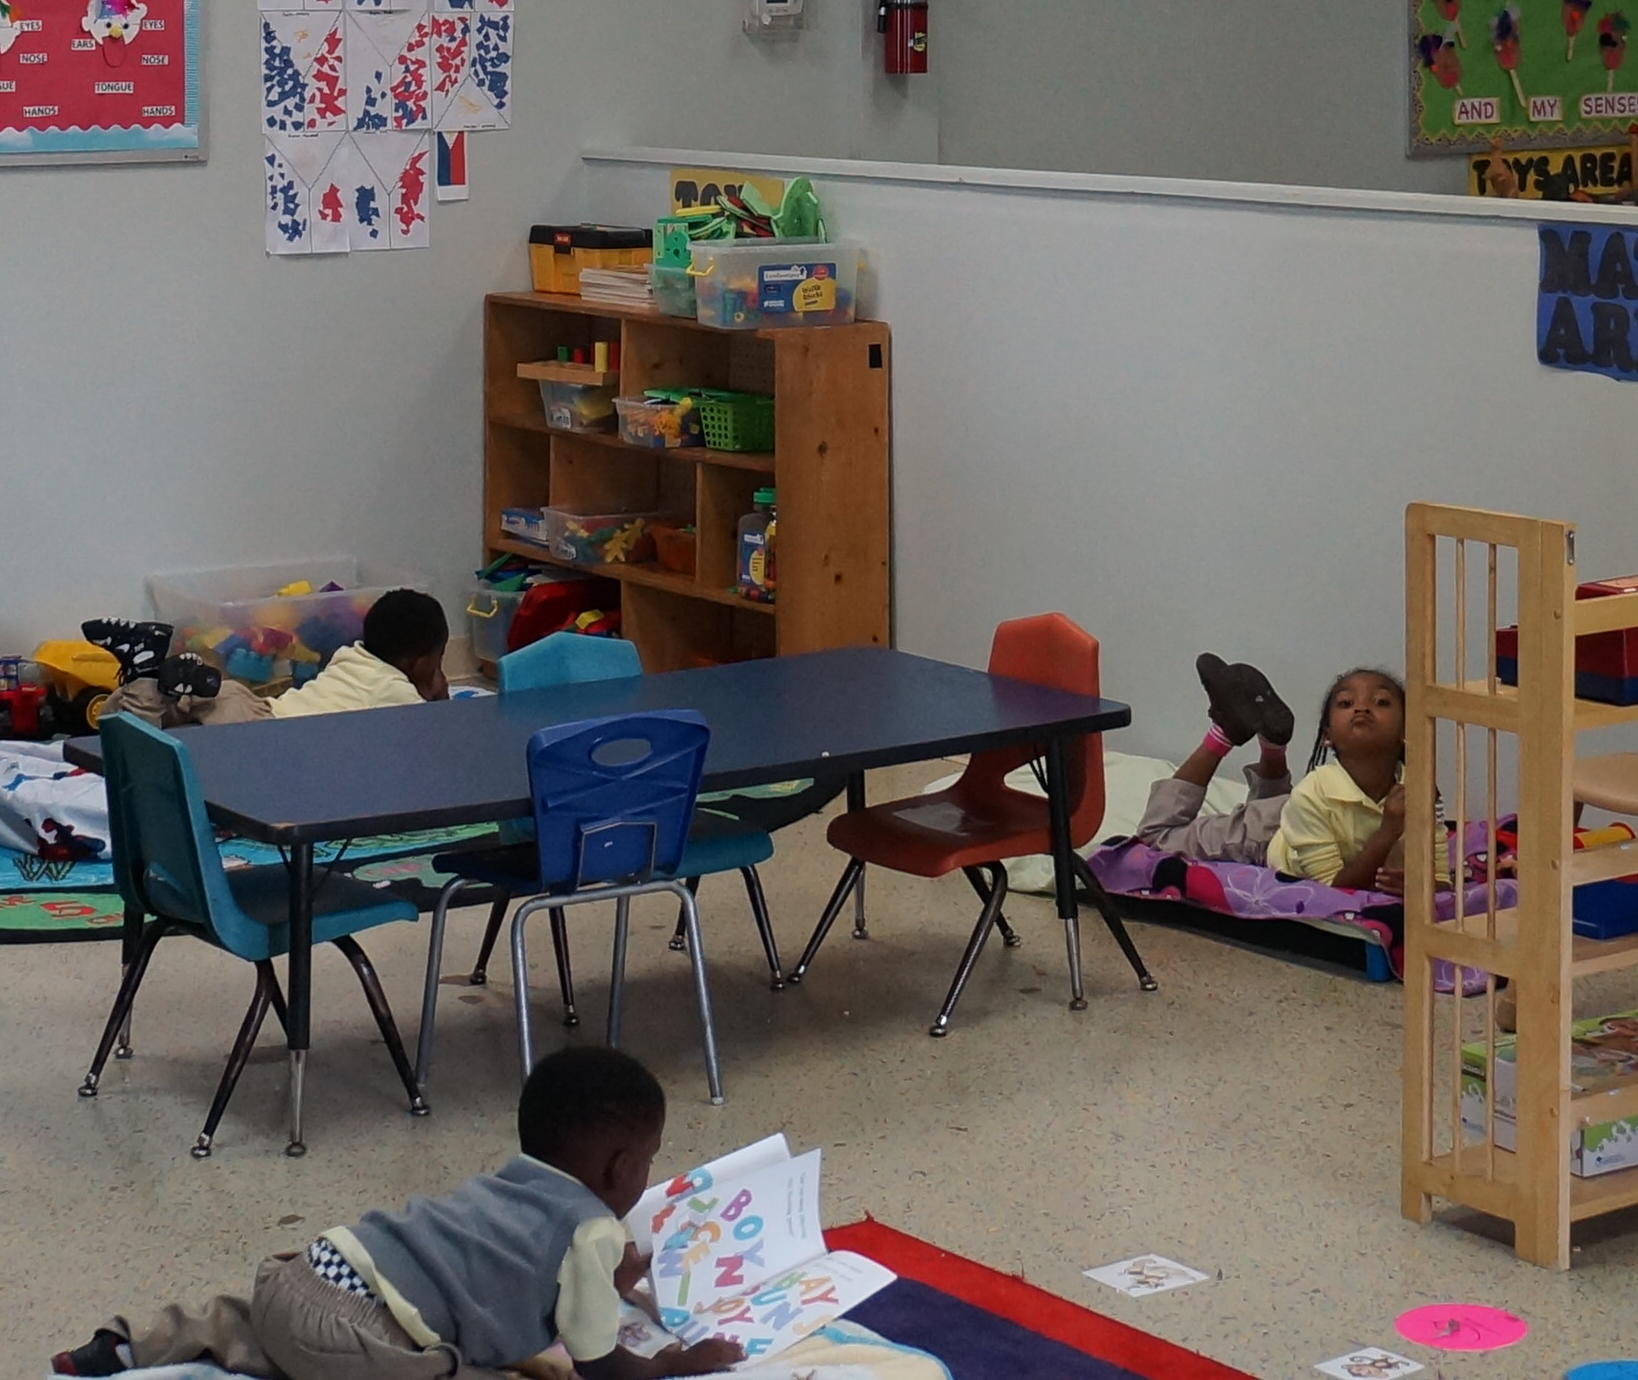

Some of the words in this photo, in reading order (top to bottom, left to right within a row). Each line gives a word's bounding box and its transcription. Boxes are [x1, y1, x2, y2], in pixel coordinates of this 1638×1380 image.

[96, 82, 132, 92] TONGUE
[24, 107, 57, 116] HANDS
[143, 106, 174, 116] HANDS
[1458, 100, 1494, 120] AND
[1531, 98, 1557, 118] MY
[1472, 154, 1554, 195] TYS
